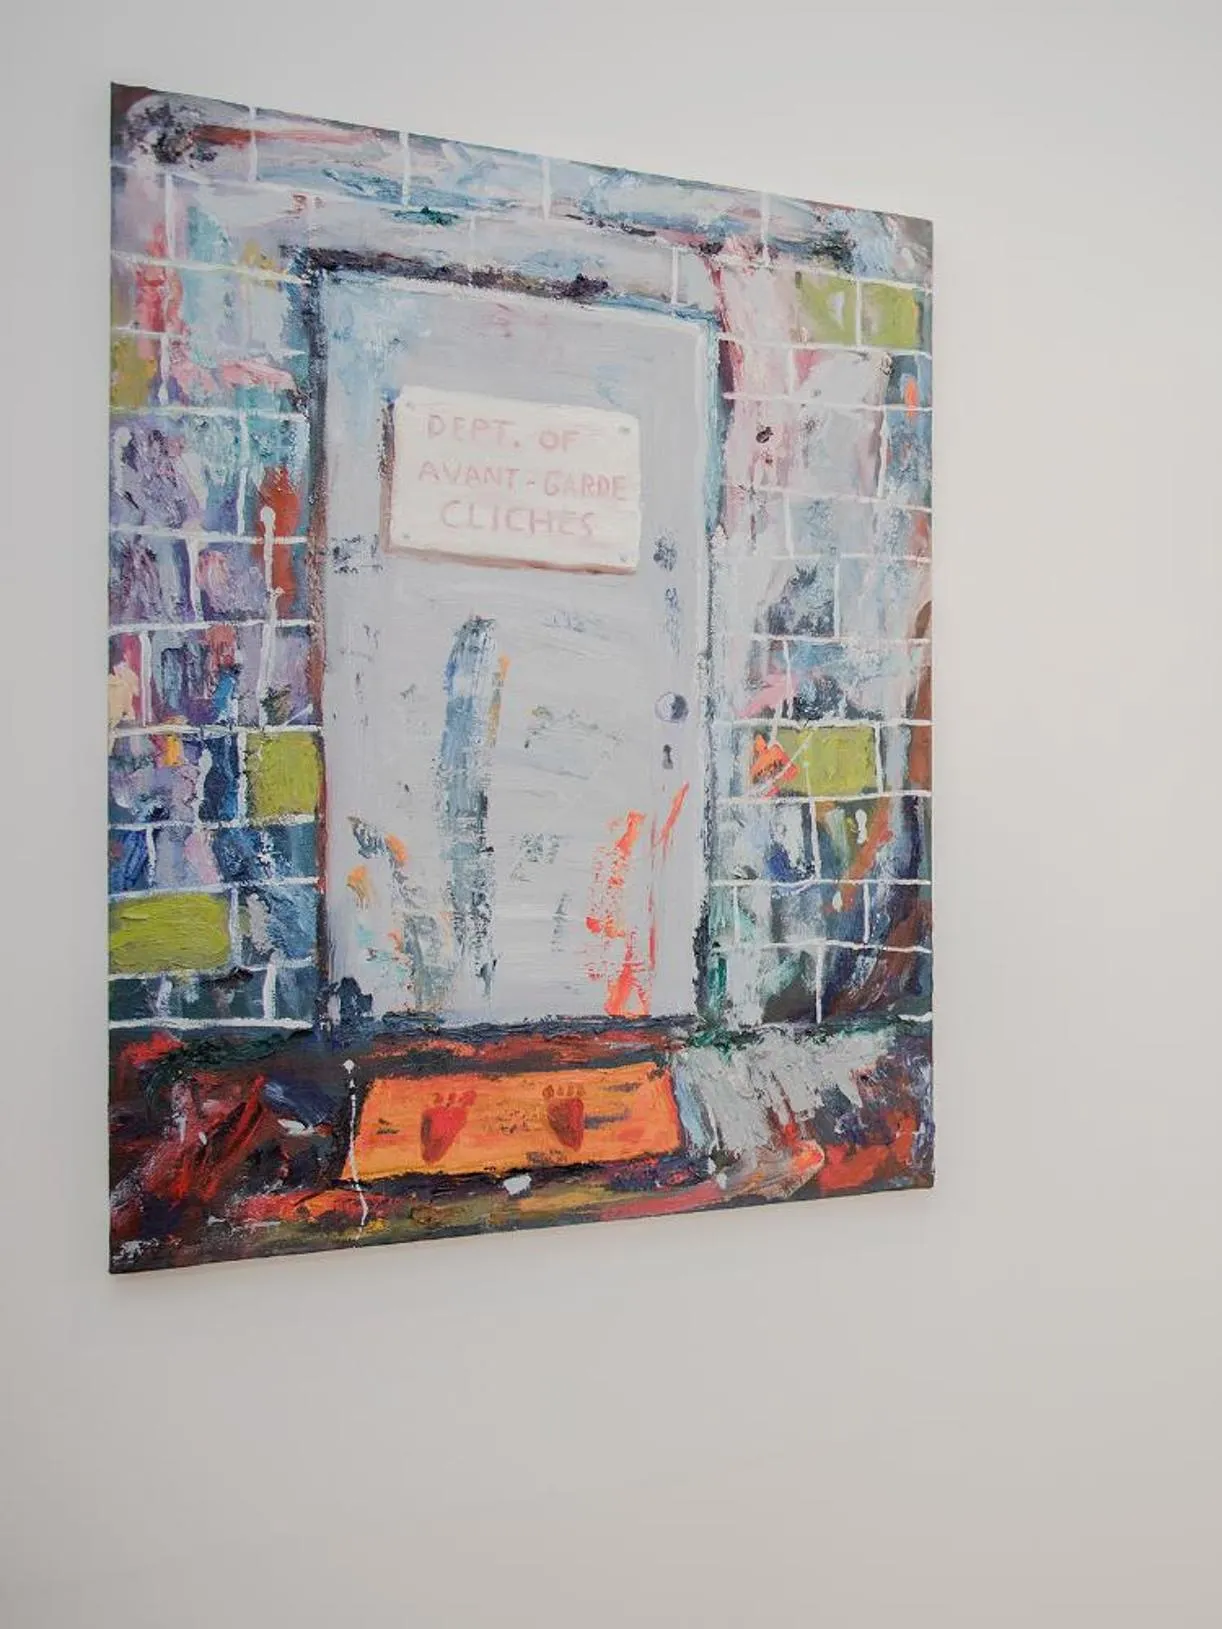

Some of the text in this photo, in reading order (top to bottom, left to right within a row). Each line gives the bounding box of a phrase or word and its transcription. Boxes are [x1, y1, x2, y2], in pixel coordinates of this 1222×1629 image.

[426, 414, 581, 451] DEPT. OF
[441, 500, 595, 537] CLICHES
